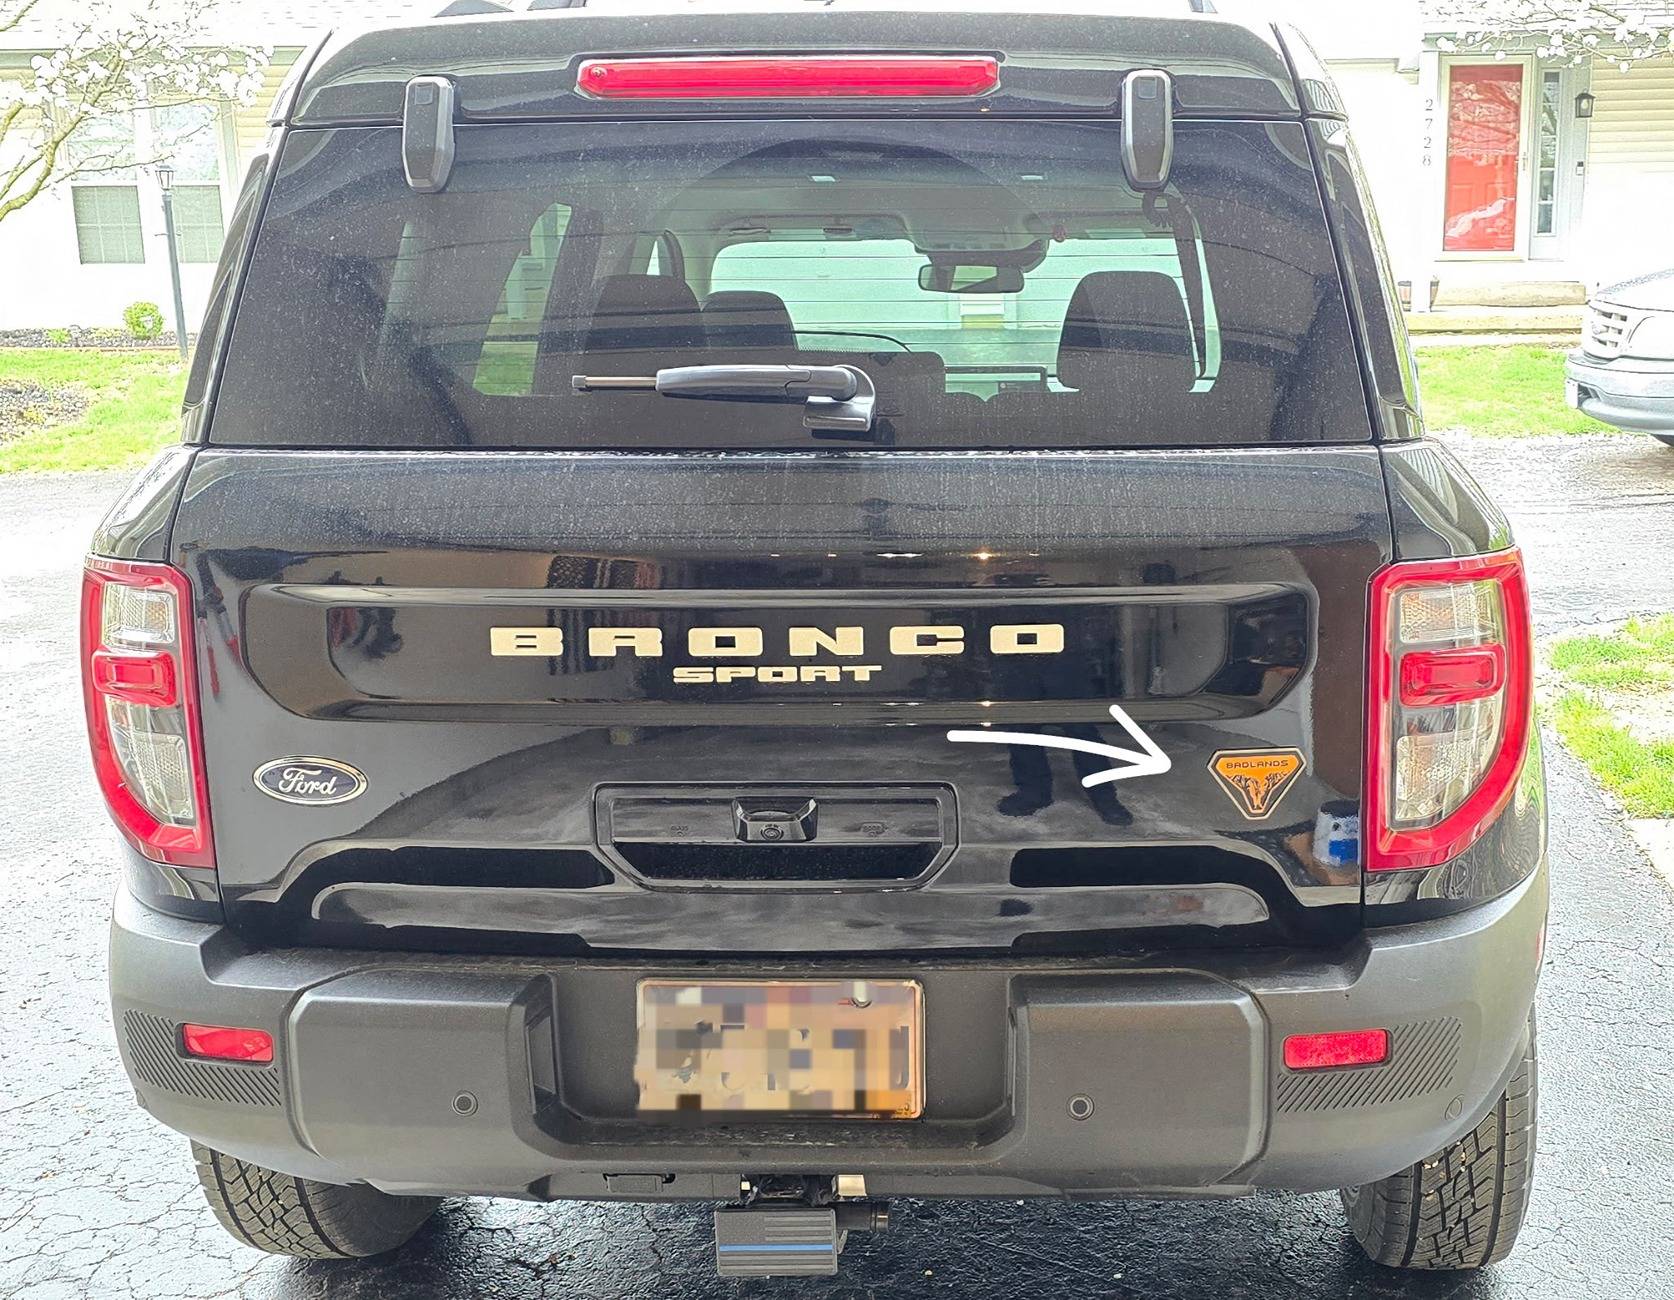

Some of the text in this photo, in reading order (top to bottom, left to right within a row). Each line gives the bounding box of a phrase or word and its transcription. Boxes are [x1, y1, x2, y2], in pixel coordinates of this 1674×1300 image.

[490, 624, 1065, 657] BRONCO
[673, 665, 882, 684] SPORT
[1226, 760, 1288, 769] BADLANDS
[278, 767, 338, 795] Ford
